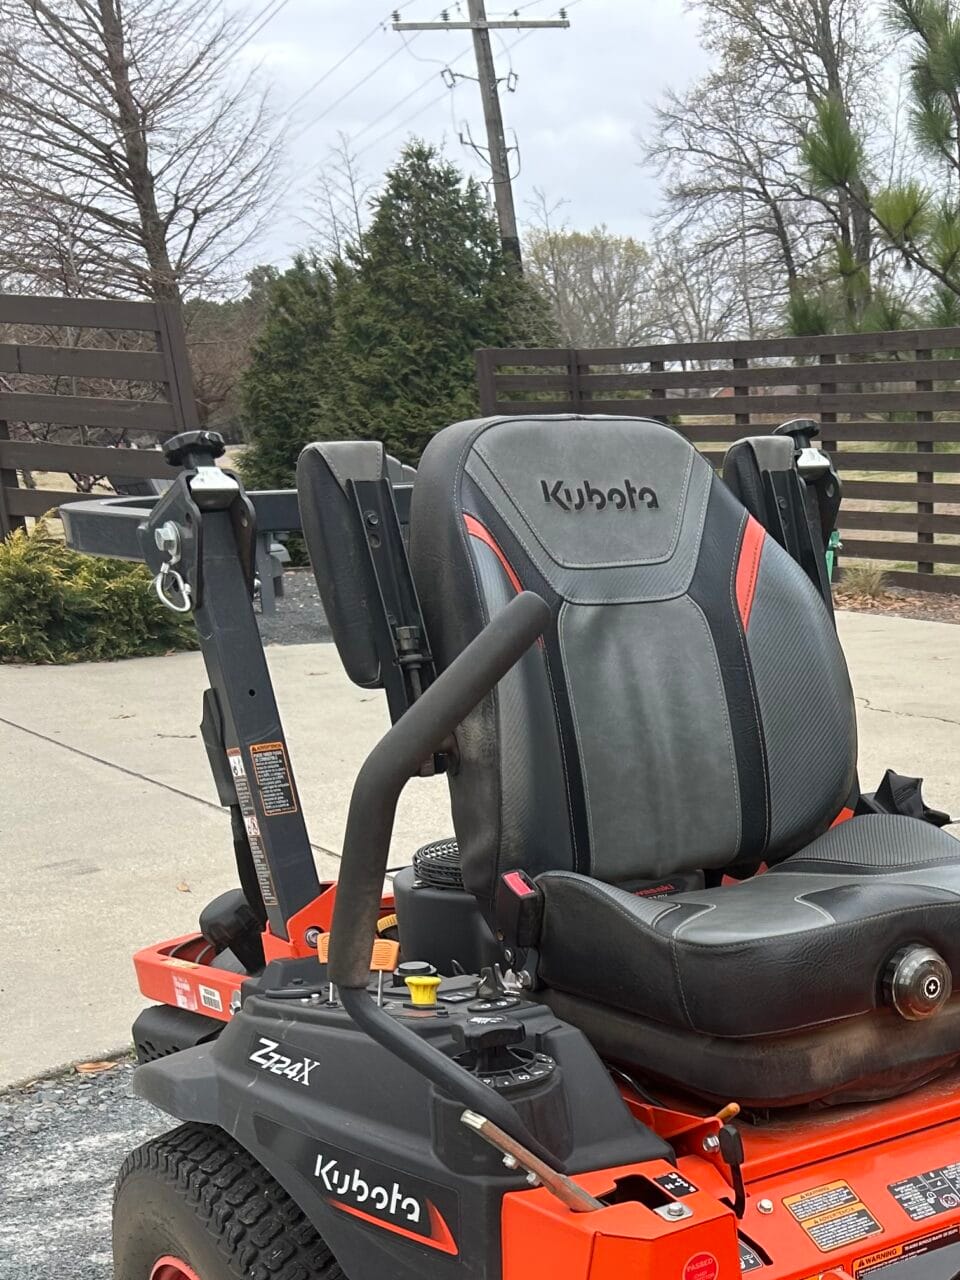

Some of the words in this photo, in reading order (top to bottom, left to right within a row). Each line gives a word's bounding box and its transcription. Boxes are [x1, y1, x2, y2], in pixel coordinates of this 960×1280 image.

[540, 479, 659, 511] Kubota
[249, 1037, 320, 1086] Z724X
[314, 1154, 420, 1223] Kubota
[866, 1248, 897, 1265] WARNING
